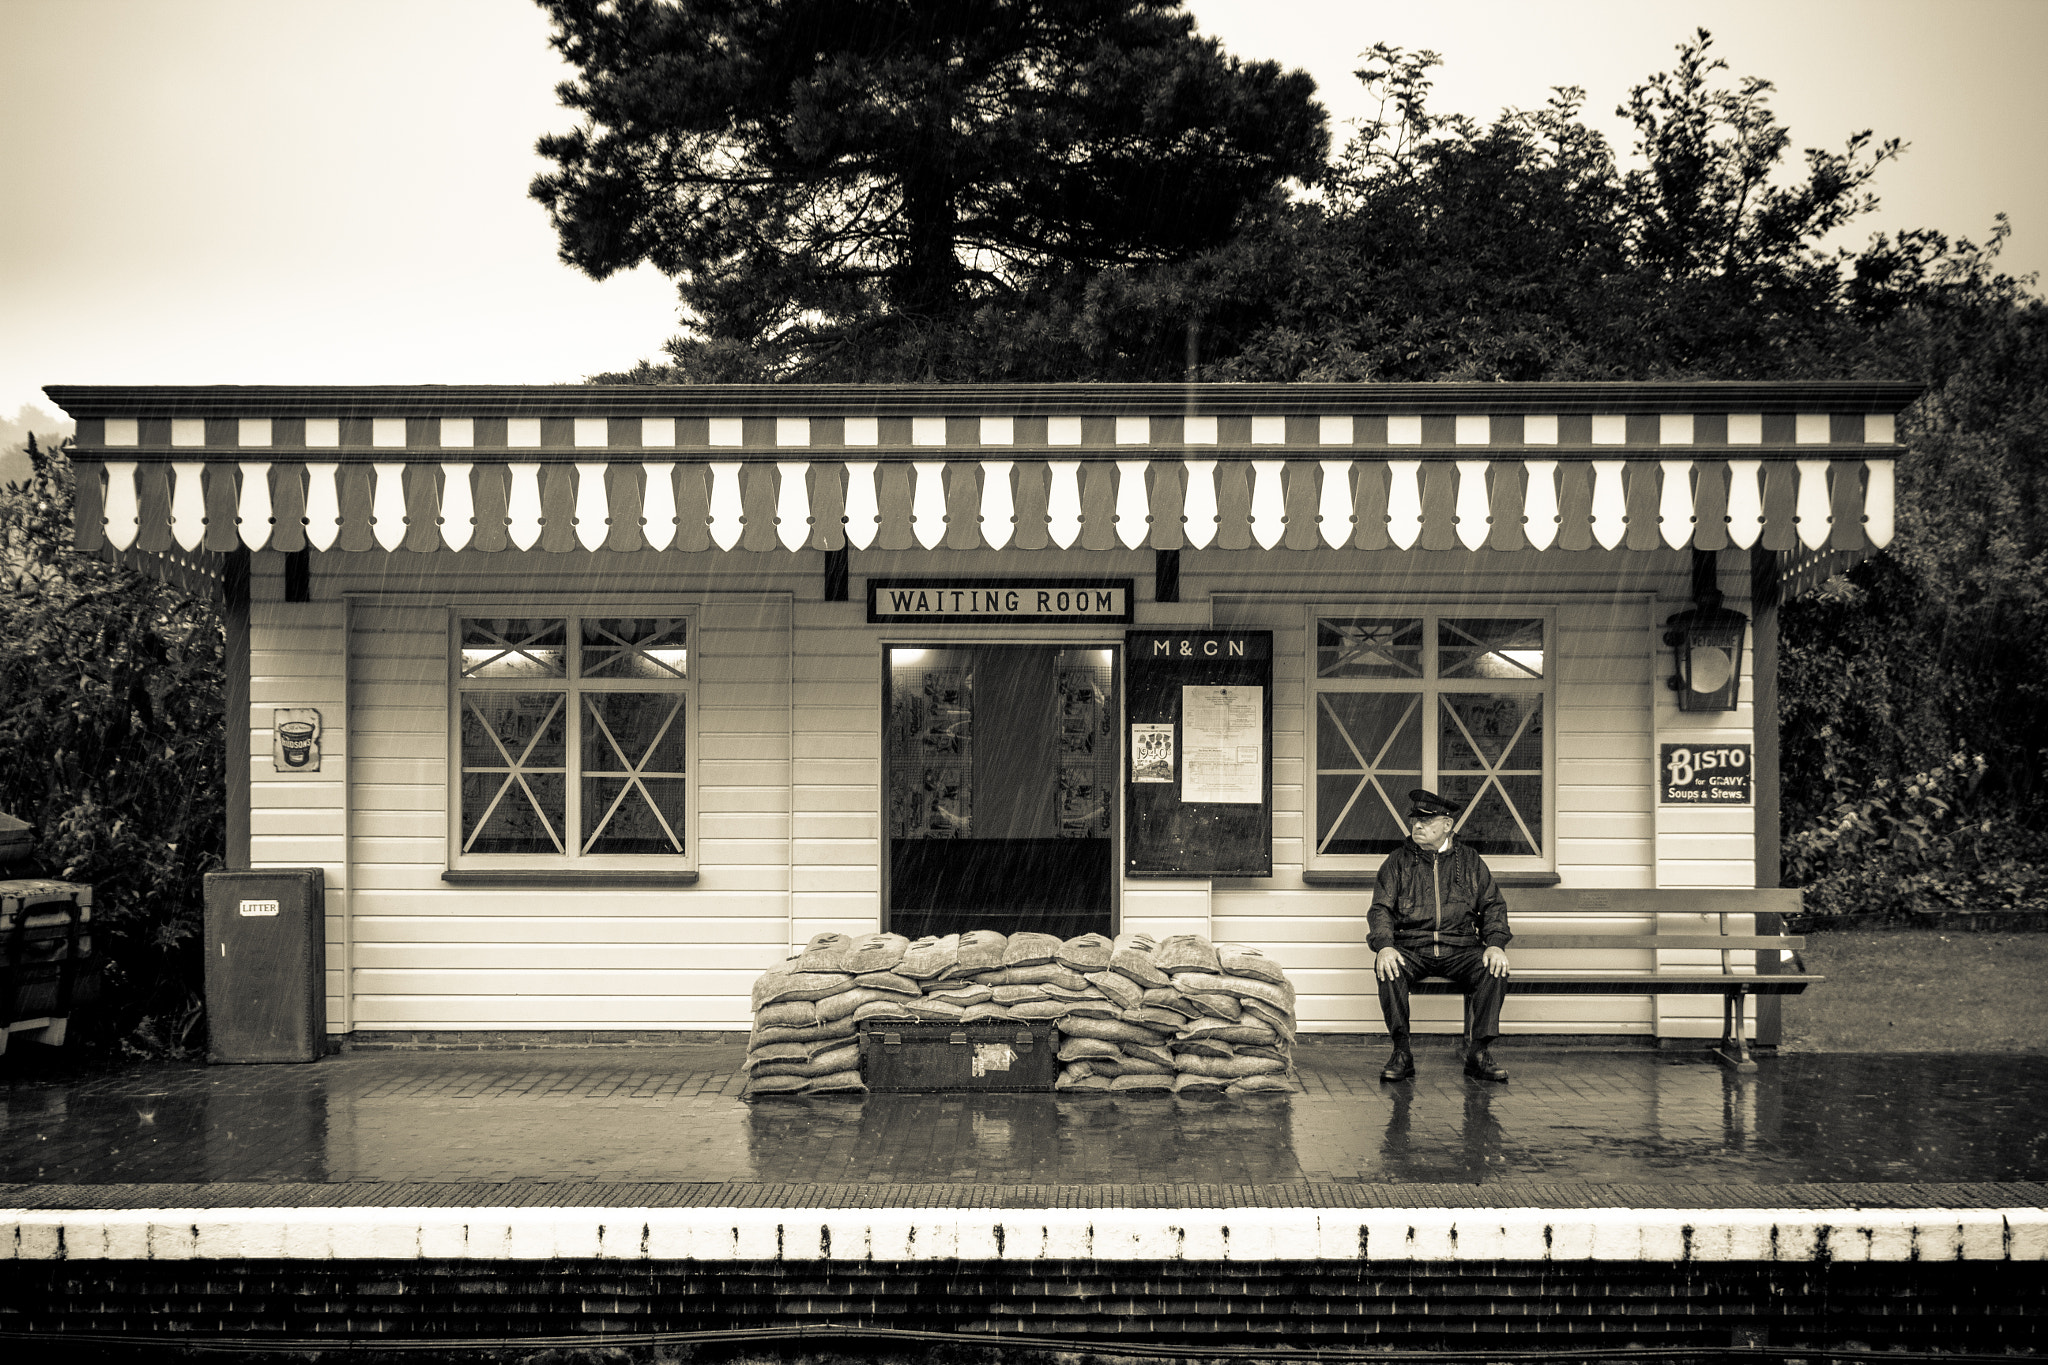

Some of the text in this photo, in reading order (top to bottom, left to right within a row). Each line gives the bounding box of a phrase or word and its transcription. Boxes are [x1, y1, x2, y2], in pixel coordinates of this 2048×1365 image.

[890, 591, 1112, 612] WAITING ROOM
[1153, 640, 1170, 656] M
[1179, 640, 1193, 656] &
[1667, 748, 1746, 787] BISTO
[1694, 778, 1707, 786] for
[1668, 787, 1746, 801] Soups & Stews.
[242, 904, 277, 912] LITTER
